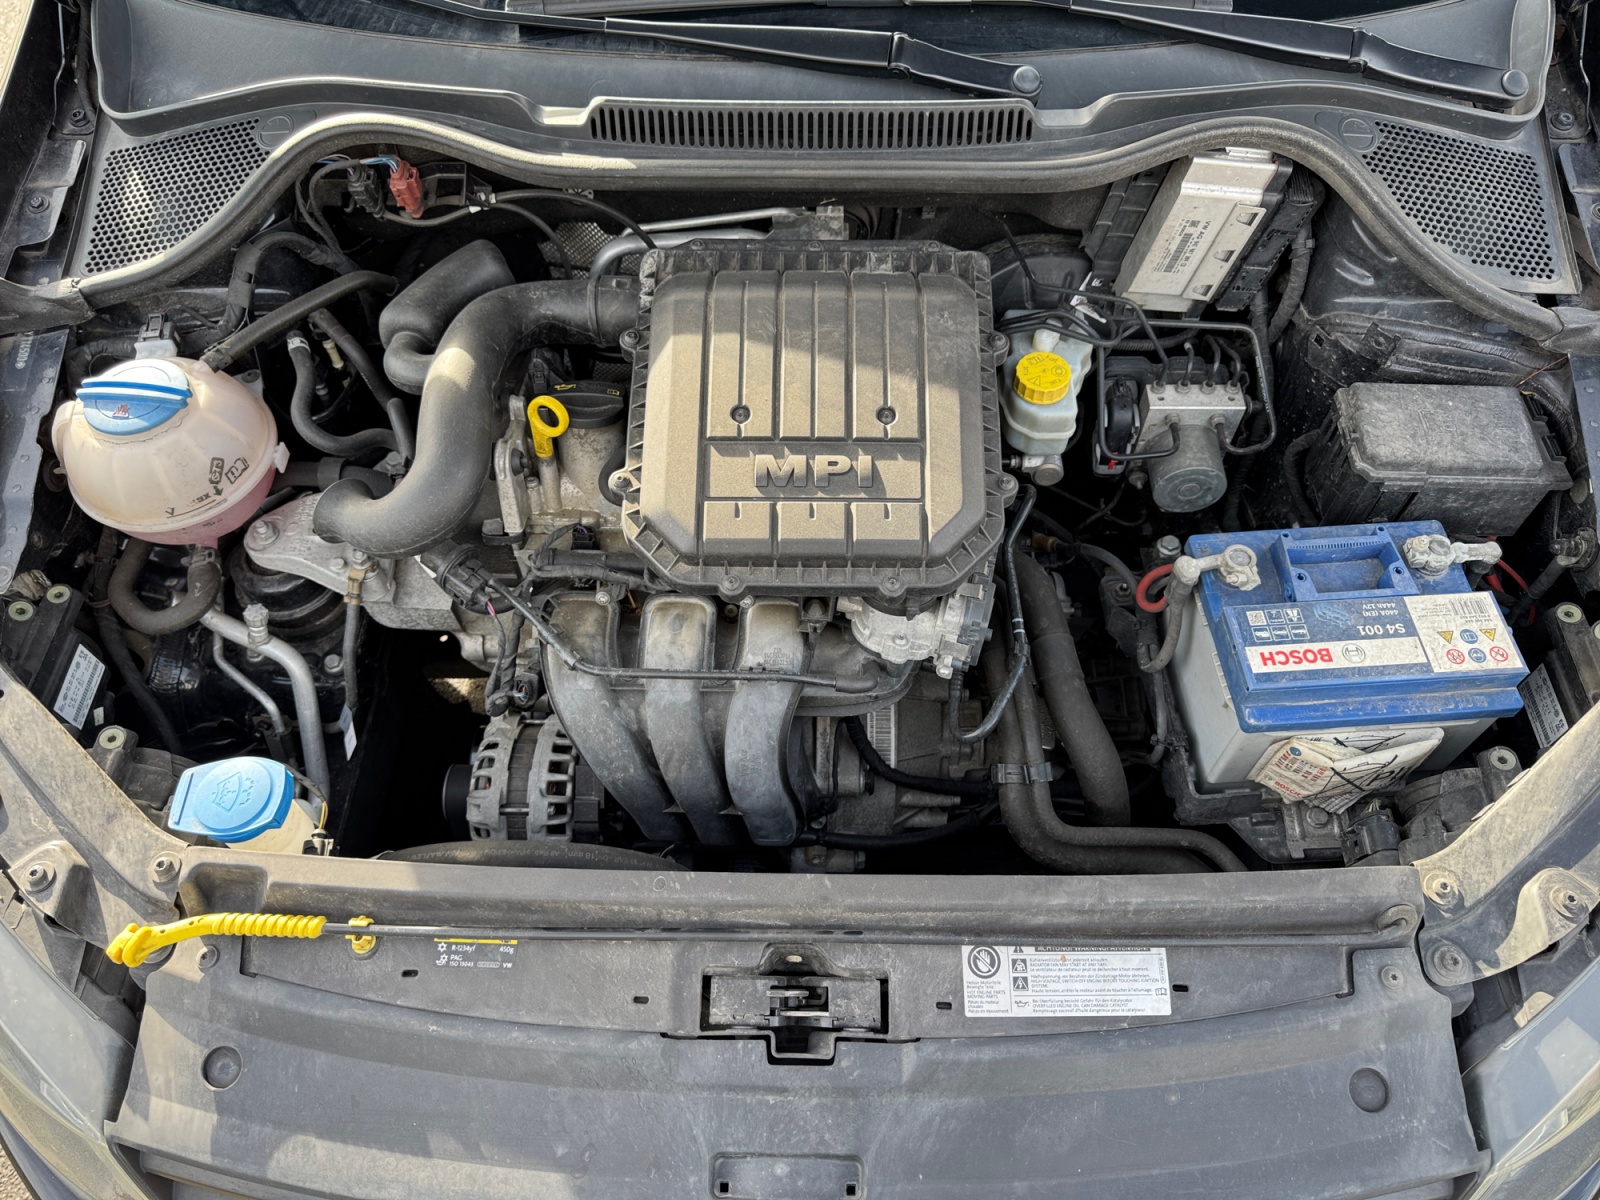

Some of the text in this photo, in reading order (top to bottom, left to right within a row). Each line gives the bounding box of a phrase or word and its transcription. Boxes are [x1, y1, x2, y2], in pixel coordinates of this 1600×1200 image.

[755, 454, 874, 488] MPI
[1356, 623, 1406, 636] S4 001
[1259, 648, 1334, 667] BOSCH
[451, 944, 514, 955] R-1234yf 450g
